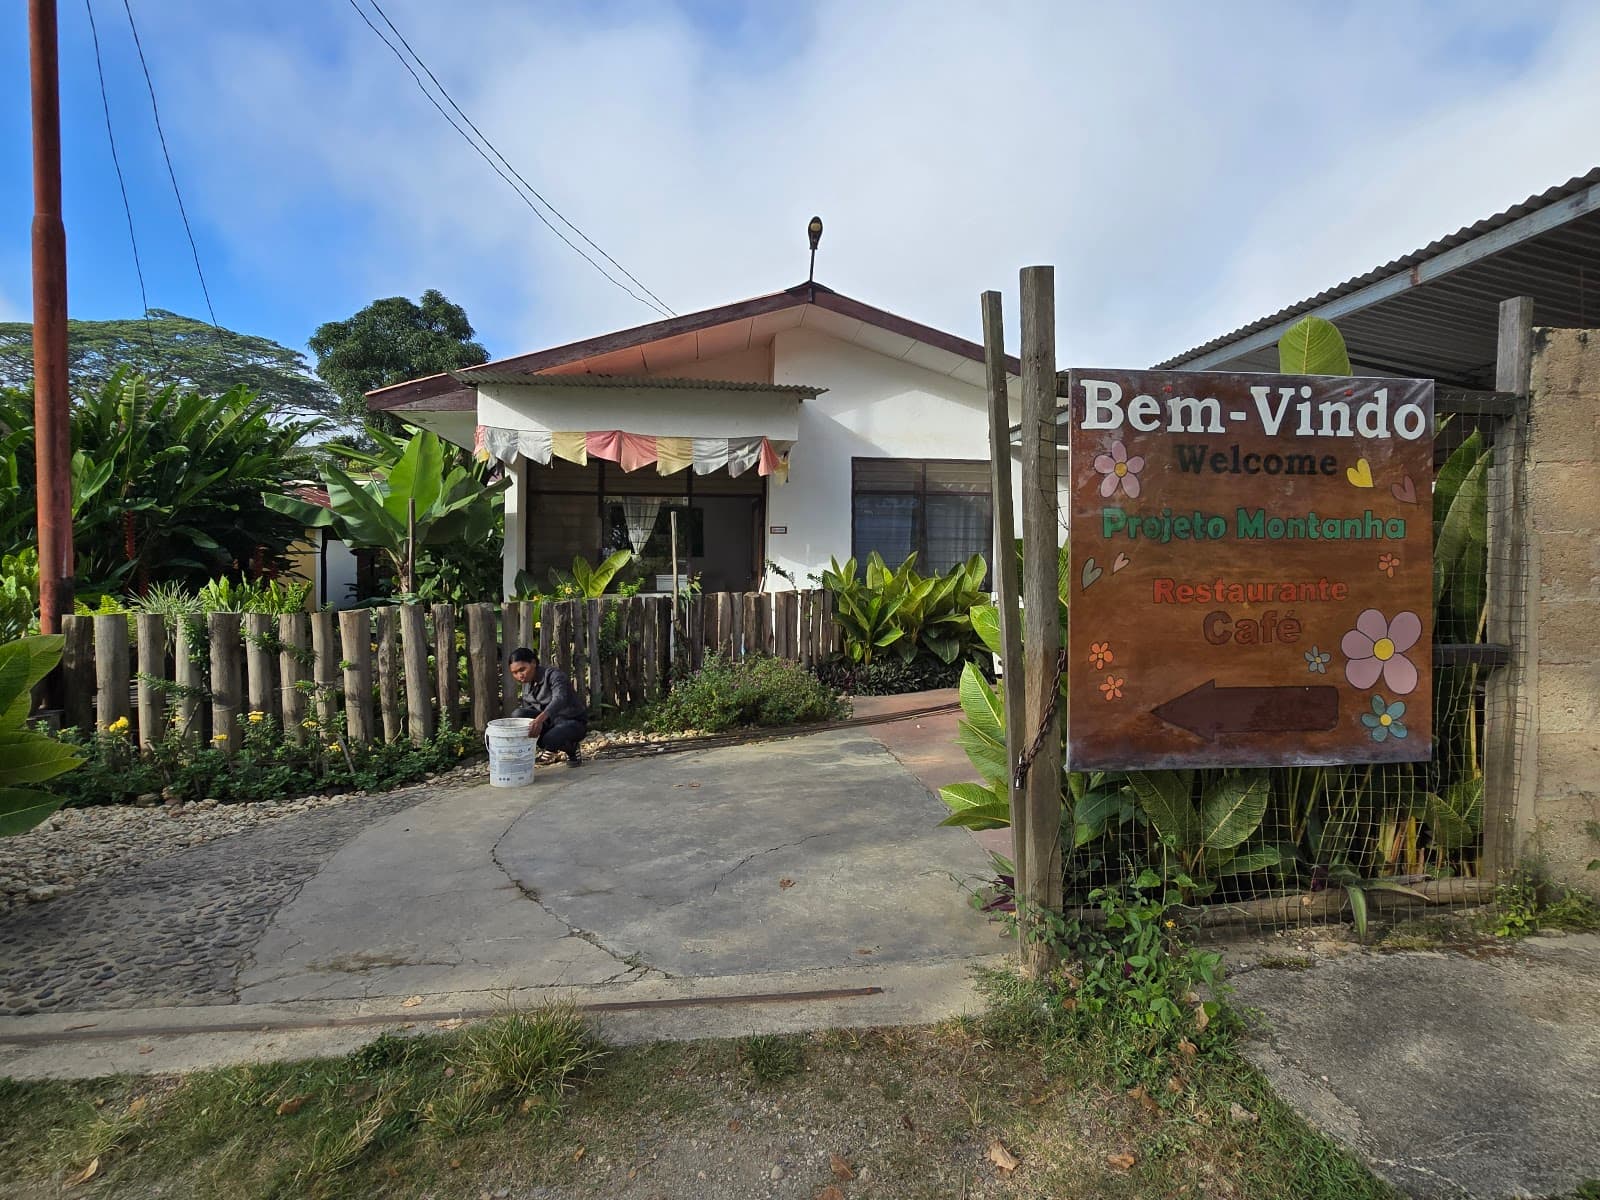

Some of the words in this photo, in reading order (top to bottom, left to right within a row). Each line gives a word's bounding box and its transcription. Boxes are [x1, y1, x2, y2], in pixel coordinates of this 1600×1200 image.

[1080, 379, 1426, 441] Bem-Vindo
[1176, 444, 1338, 476] Welcome
[1102, 507, 1228, 544] Projeto
[1236, 507, 1407, 540] Montanha
[1153, 576, 1349, 605] Restaurante
[1203, 608, 1302, 645] Café
